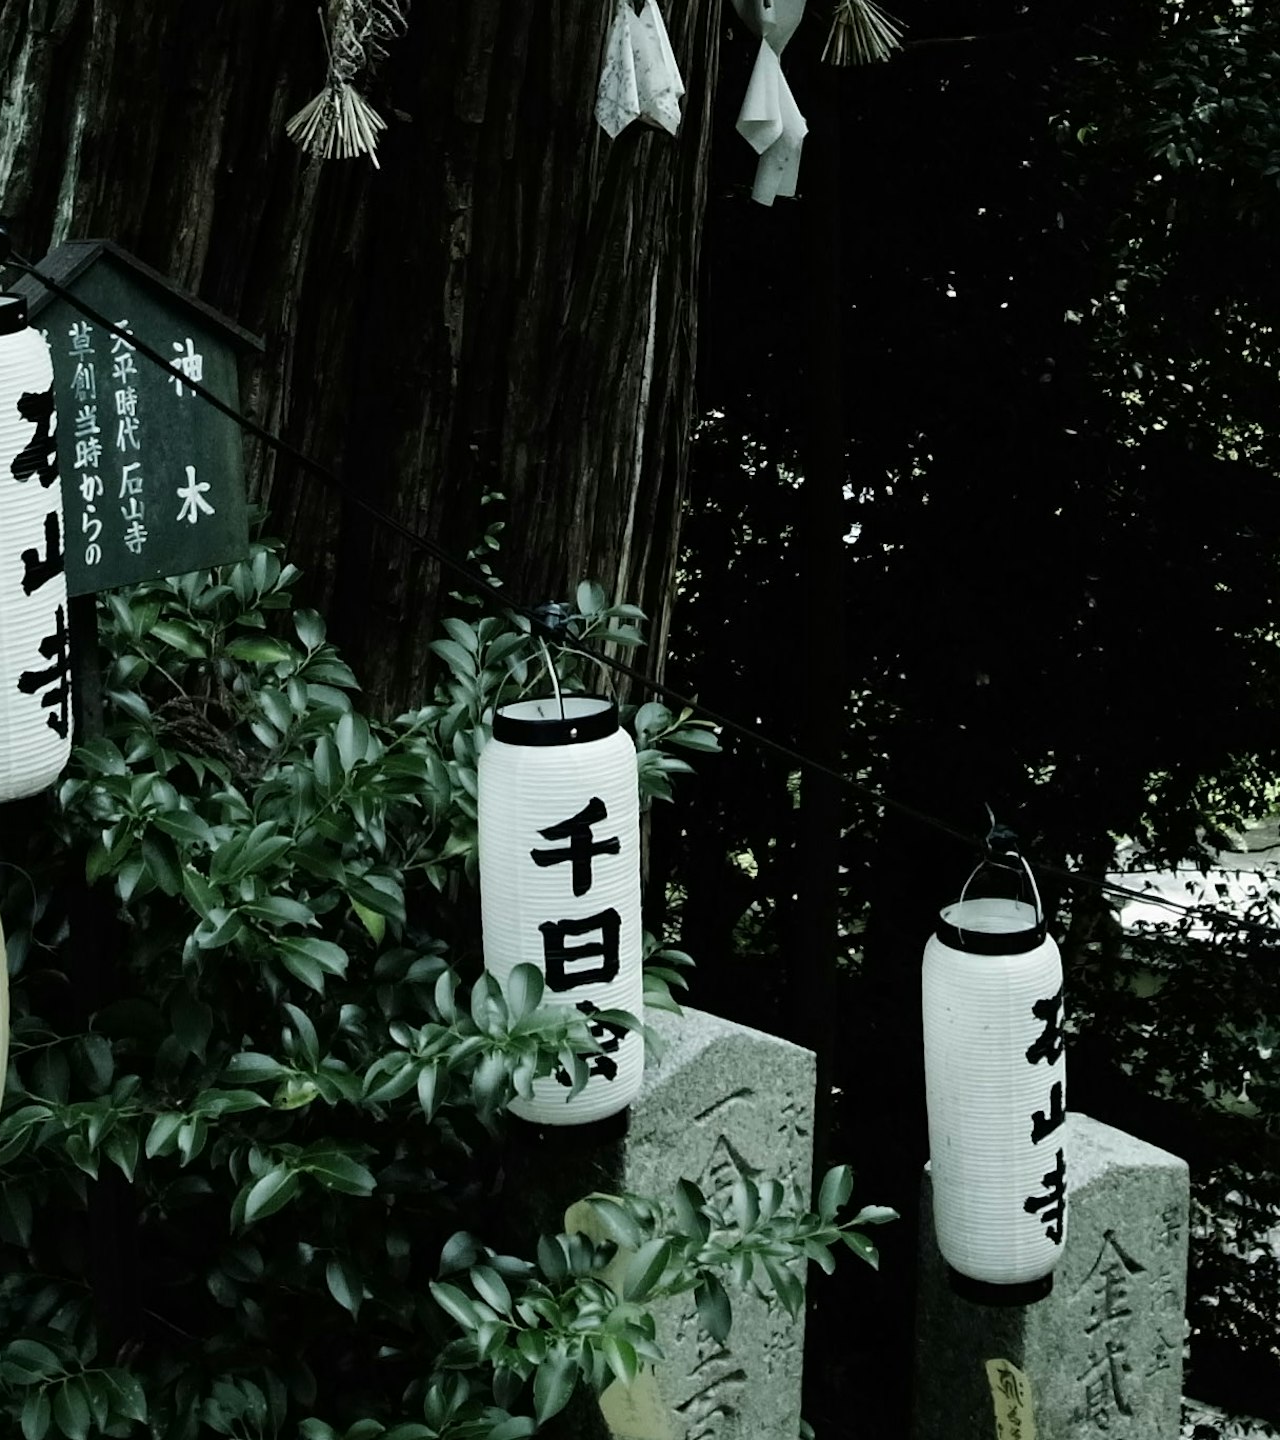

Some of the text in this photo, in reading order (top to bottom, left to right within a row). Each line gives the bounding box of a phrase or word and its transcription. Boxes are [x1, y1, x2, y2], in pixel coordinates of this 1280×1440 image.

[68, 320, 104, 566] 草創当時からの
[168, 337, 216, 524] 神木
